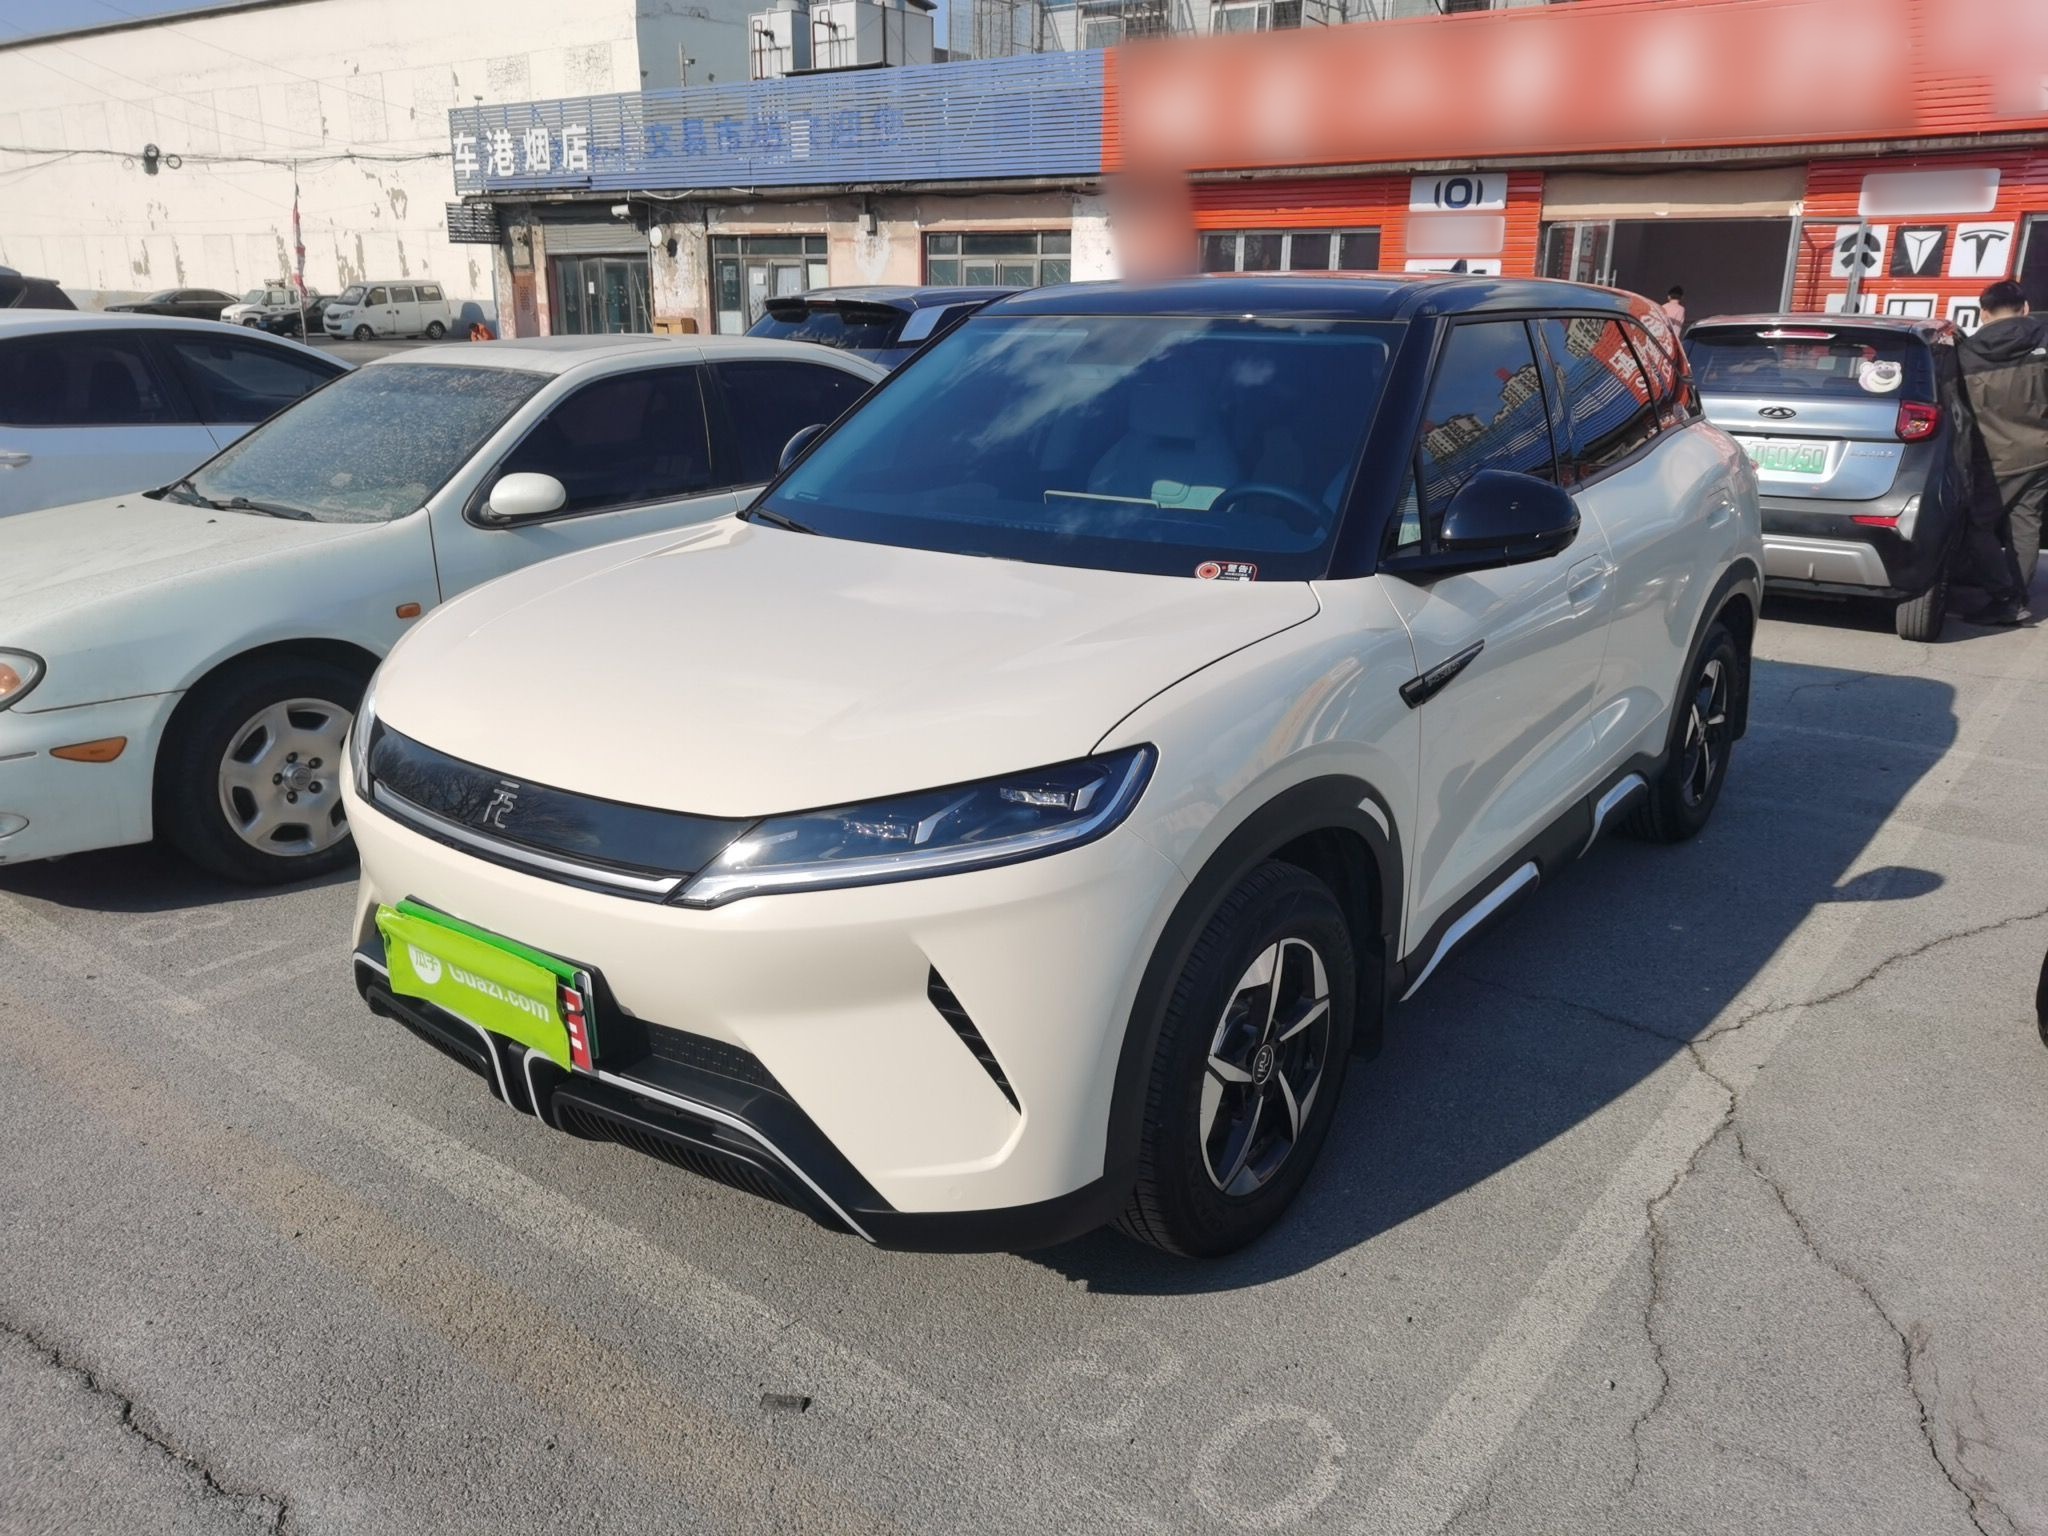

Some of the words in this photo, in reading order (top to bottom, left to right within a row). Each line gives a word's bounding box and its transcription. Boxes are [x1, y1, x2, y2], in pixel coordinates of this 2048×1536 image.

[454, 124, 588, 180] 车港烟店
[483, 780, 521, 829] 元
[447, 962, 550, 1023] Guazi.com
